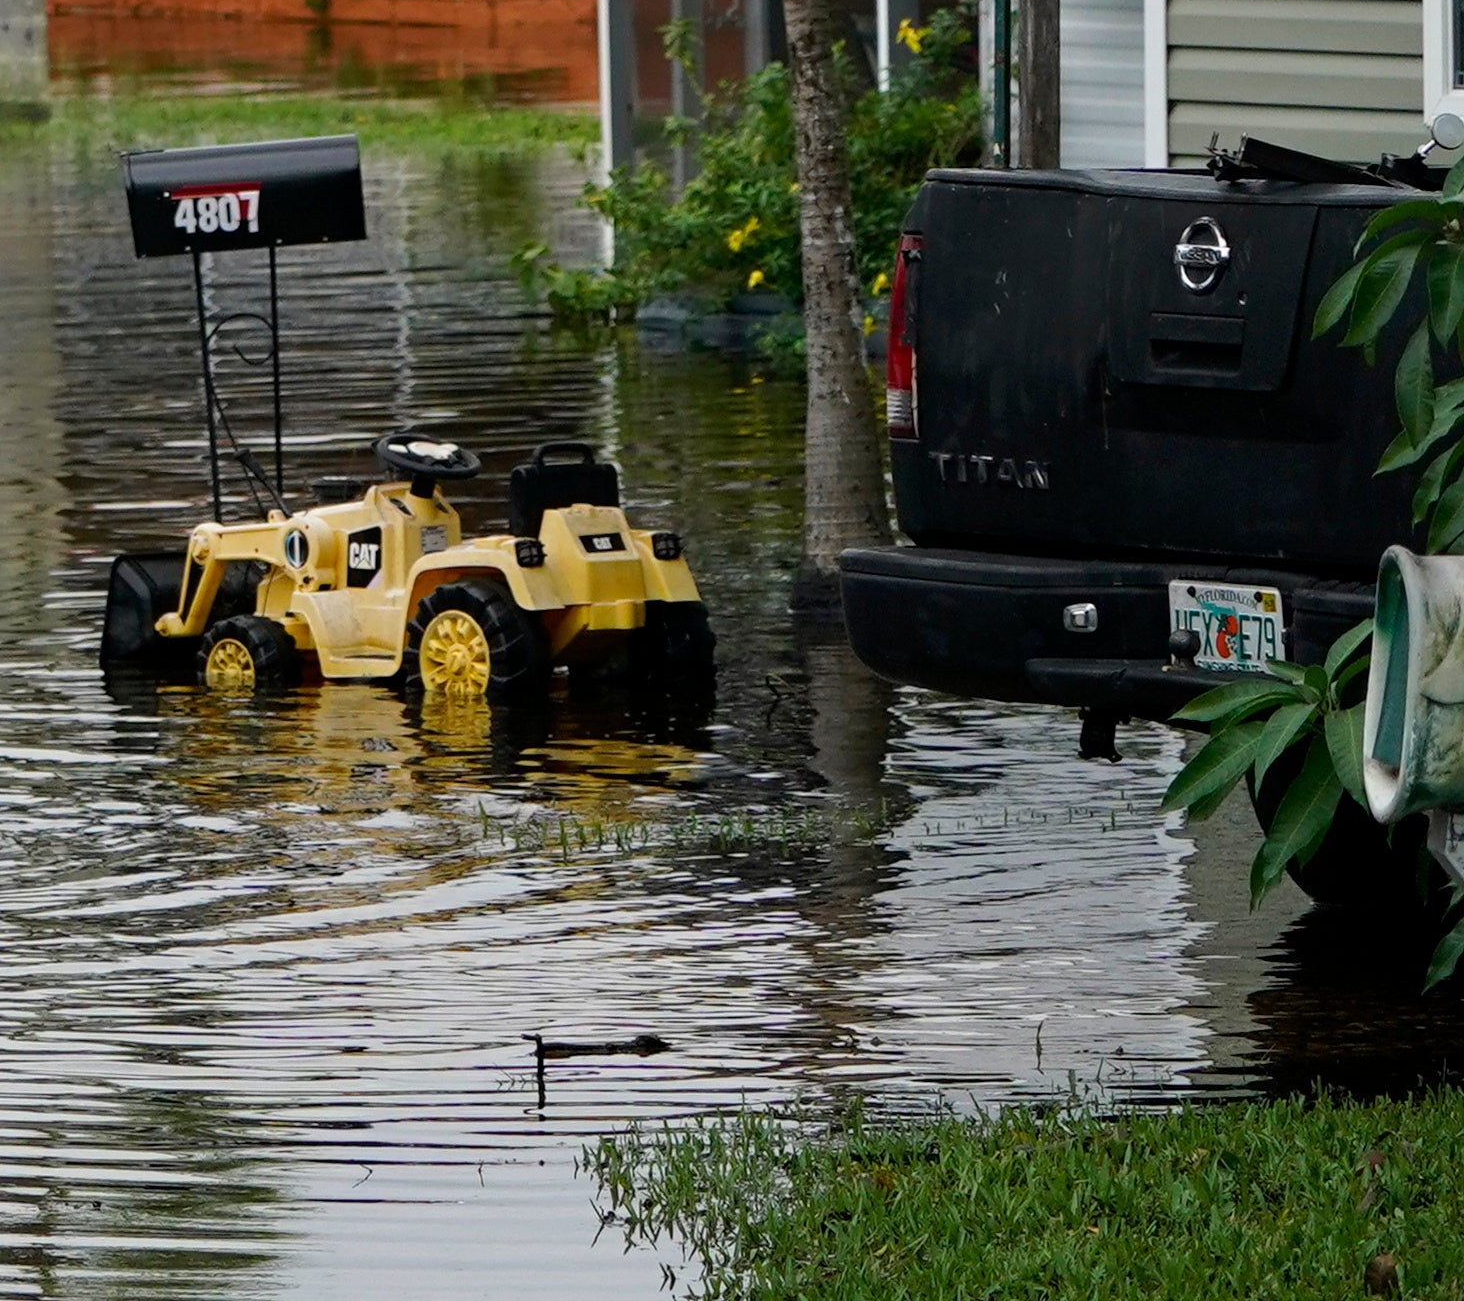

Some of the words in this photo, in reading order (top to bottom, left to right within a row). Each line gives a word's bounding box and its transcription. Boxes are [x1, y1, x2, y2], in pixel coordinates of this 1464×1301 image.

[174, 190, 261, 234] 4807
[928, 450, 1050, 490] TITAN
[349, 541, 380, 570] CAT
[592, 536, 613, 550] CAT
[1238, 614, 1277, 661] E79
